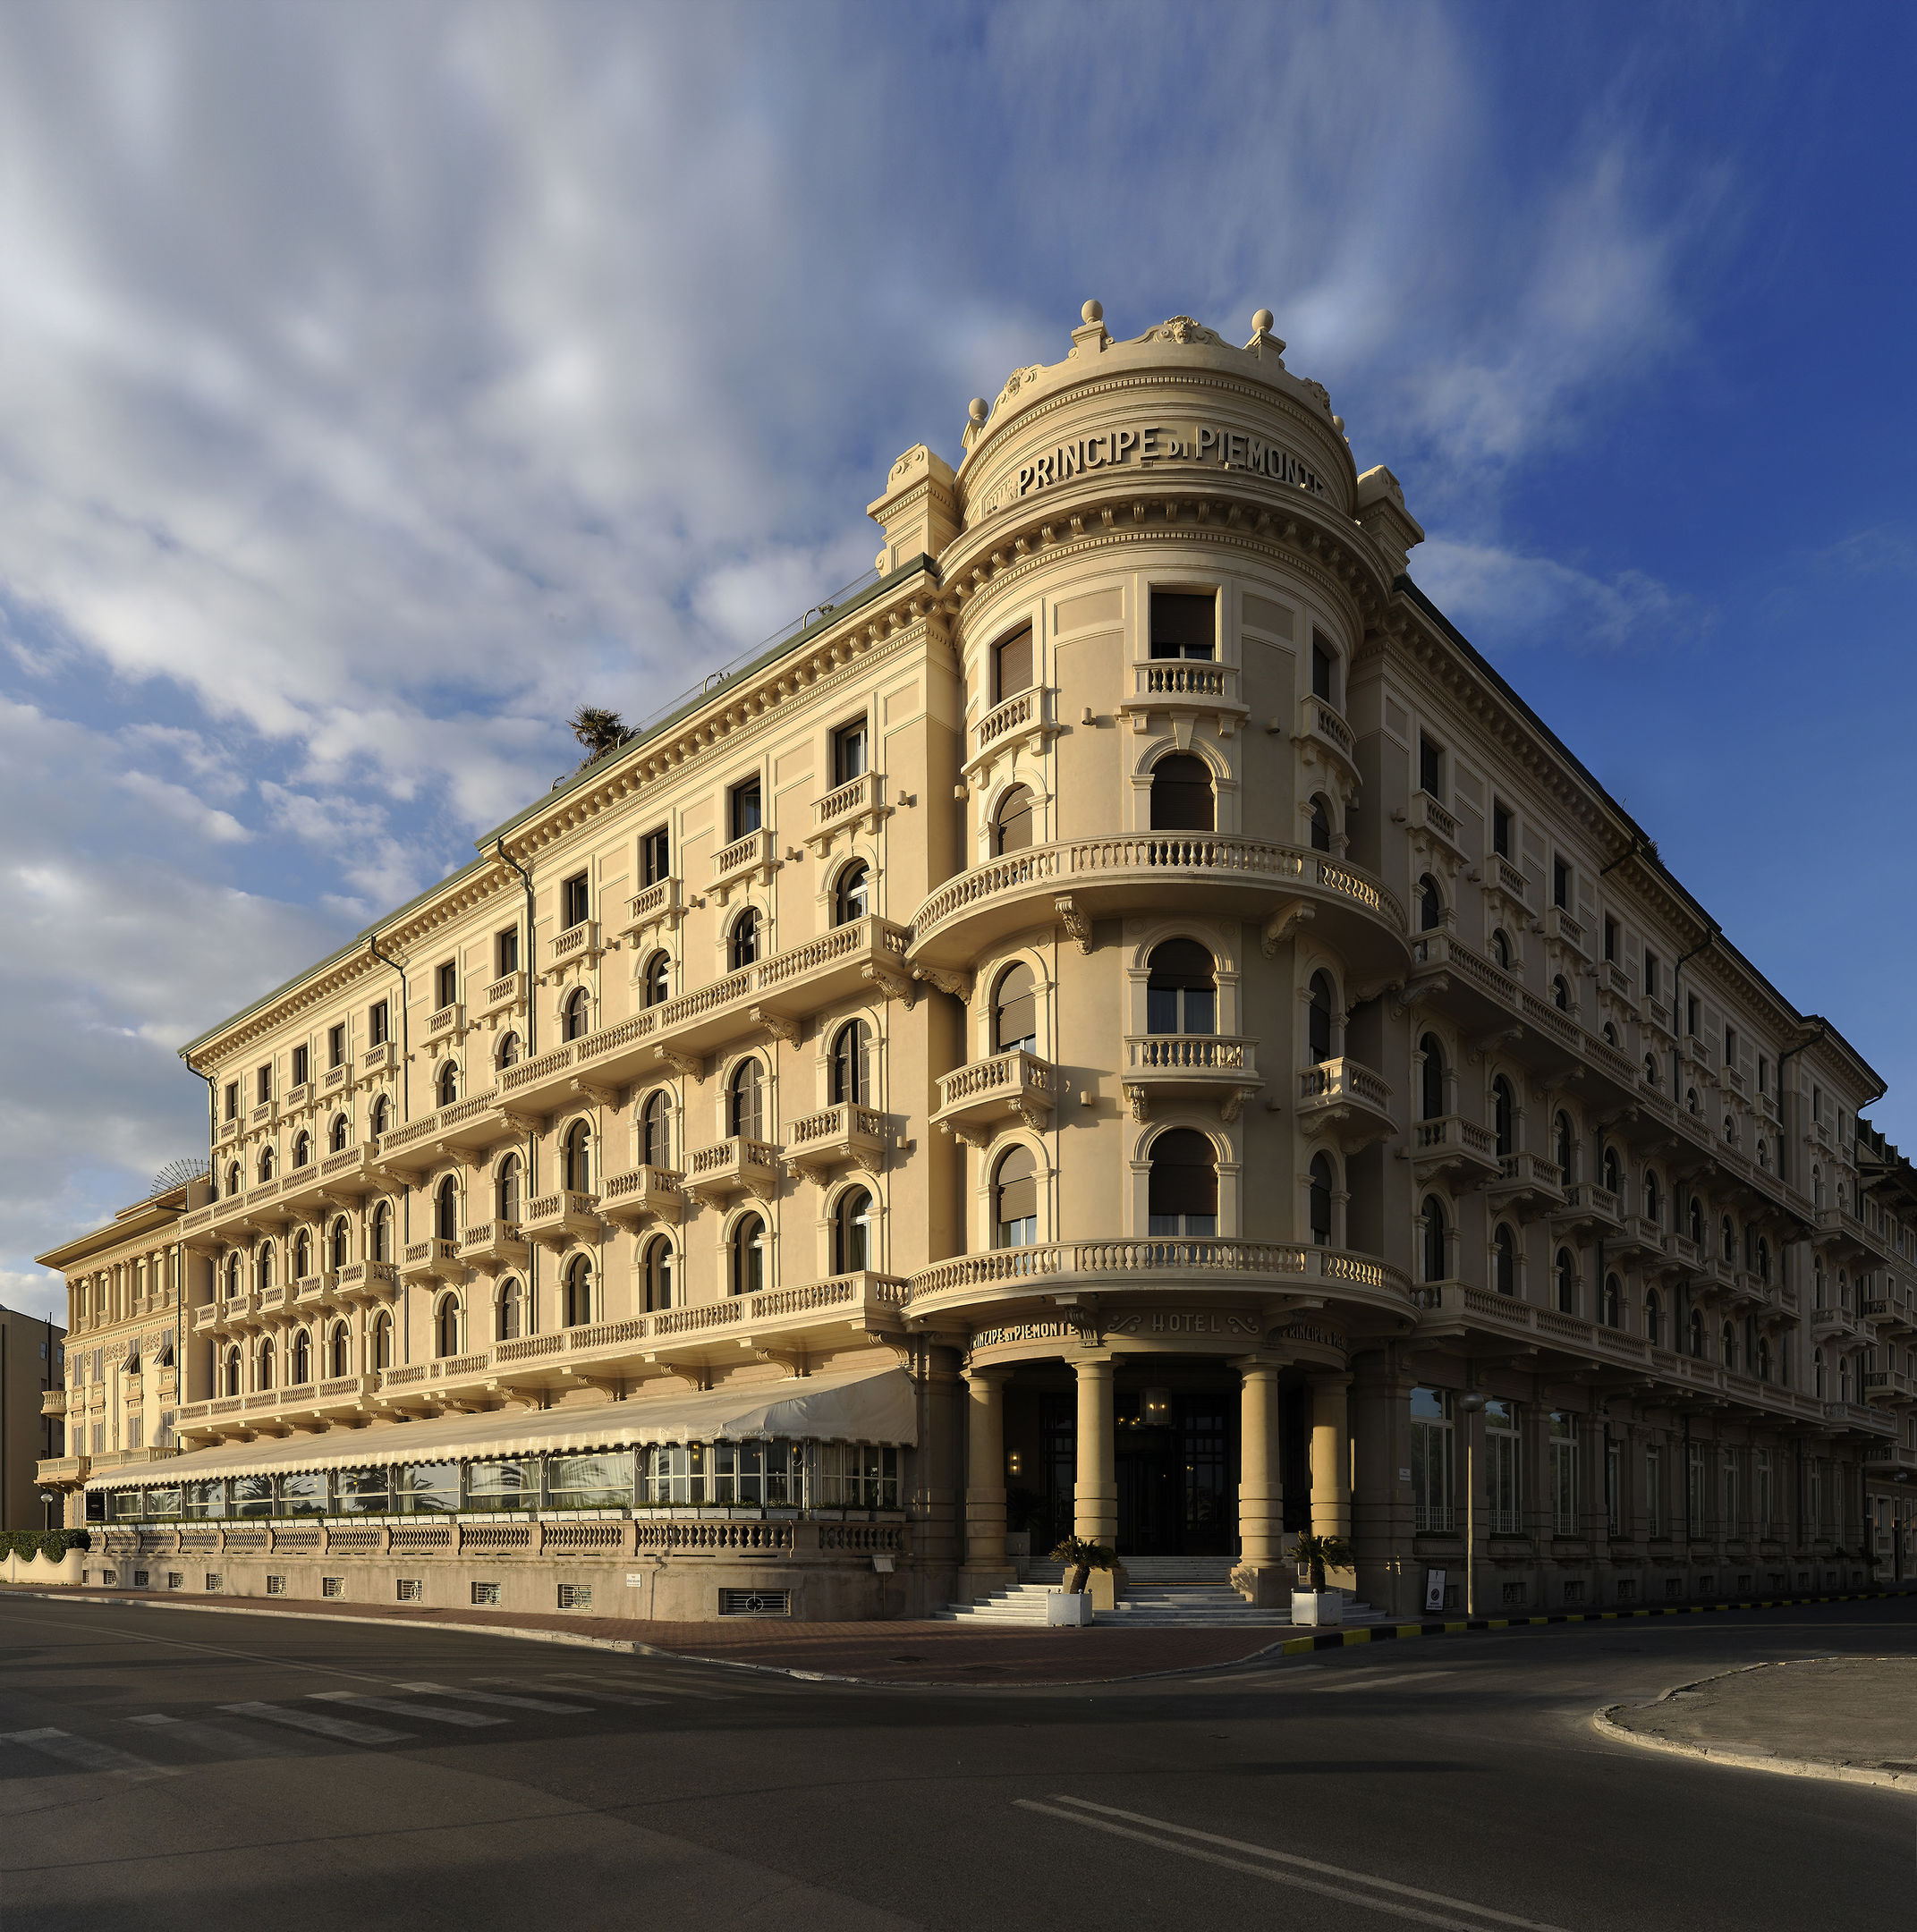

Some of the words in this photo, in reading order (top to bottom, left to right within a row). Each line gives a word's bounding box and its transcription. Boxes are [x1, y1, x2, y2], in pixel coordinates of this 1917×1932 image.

[1019, 426, 1159, 496] PRINCIPE
[1167, 437, 1189, 459] DI
[1014, 1322, 1077, 1342] PIEMONTE
[1151, 1313, 1221, 1333] HOTEL
